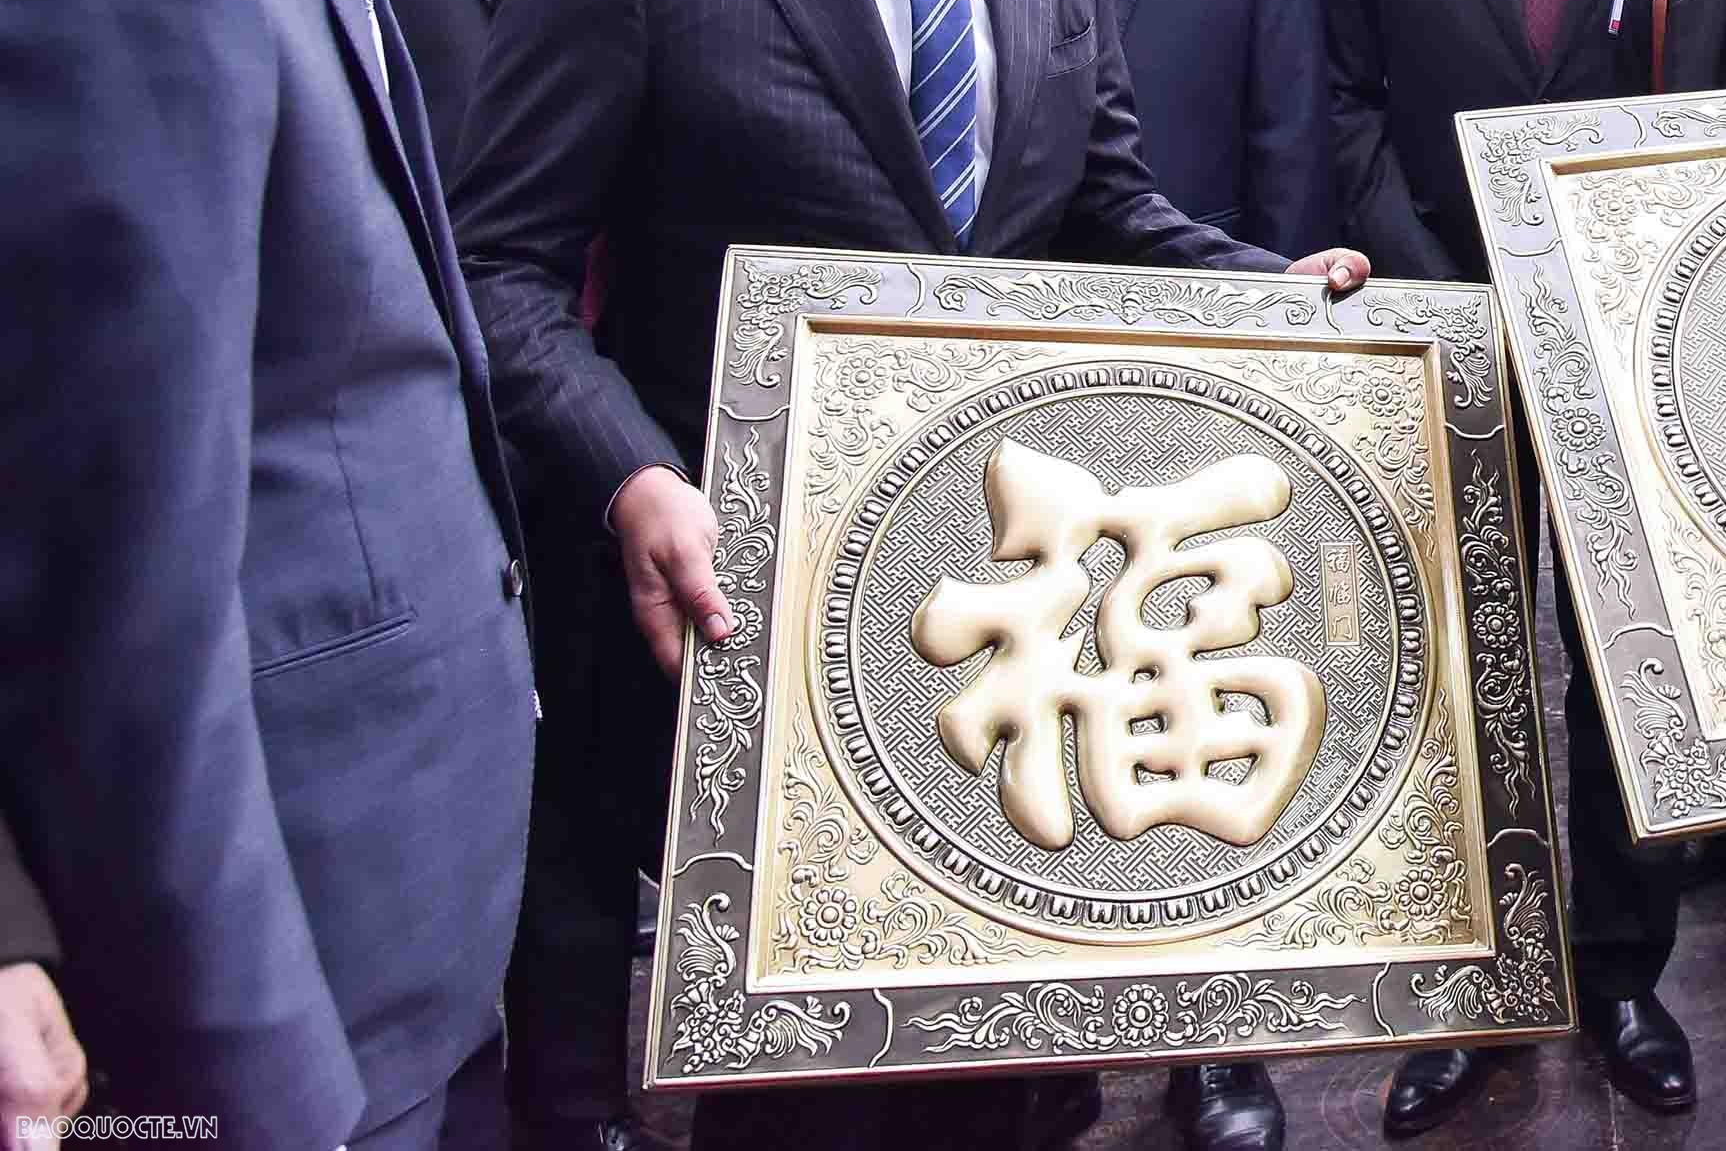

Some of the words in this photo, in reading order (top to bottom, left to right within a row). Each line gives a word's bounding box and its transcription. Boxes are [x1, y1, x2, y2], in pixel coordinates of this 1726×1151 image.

[911, 435, 1328, 850] 福
[1325, 548, 1354, 641] 福临门
